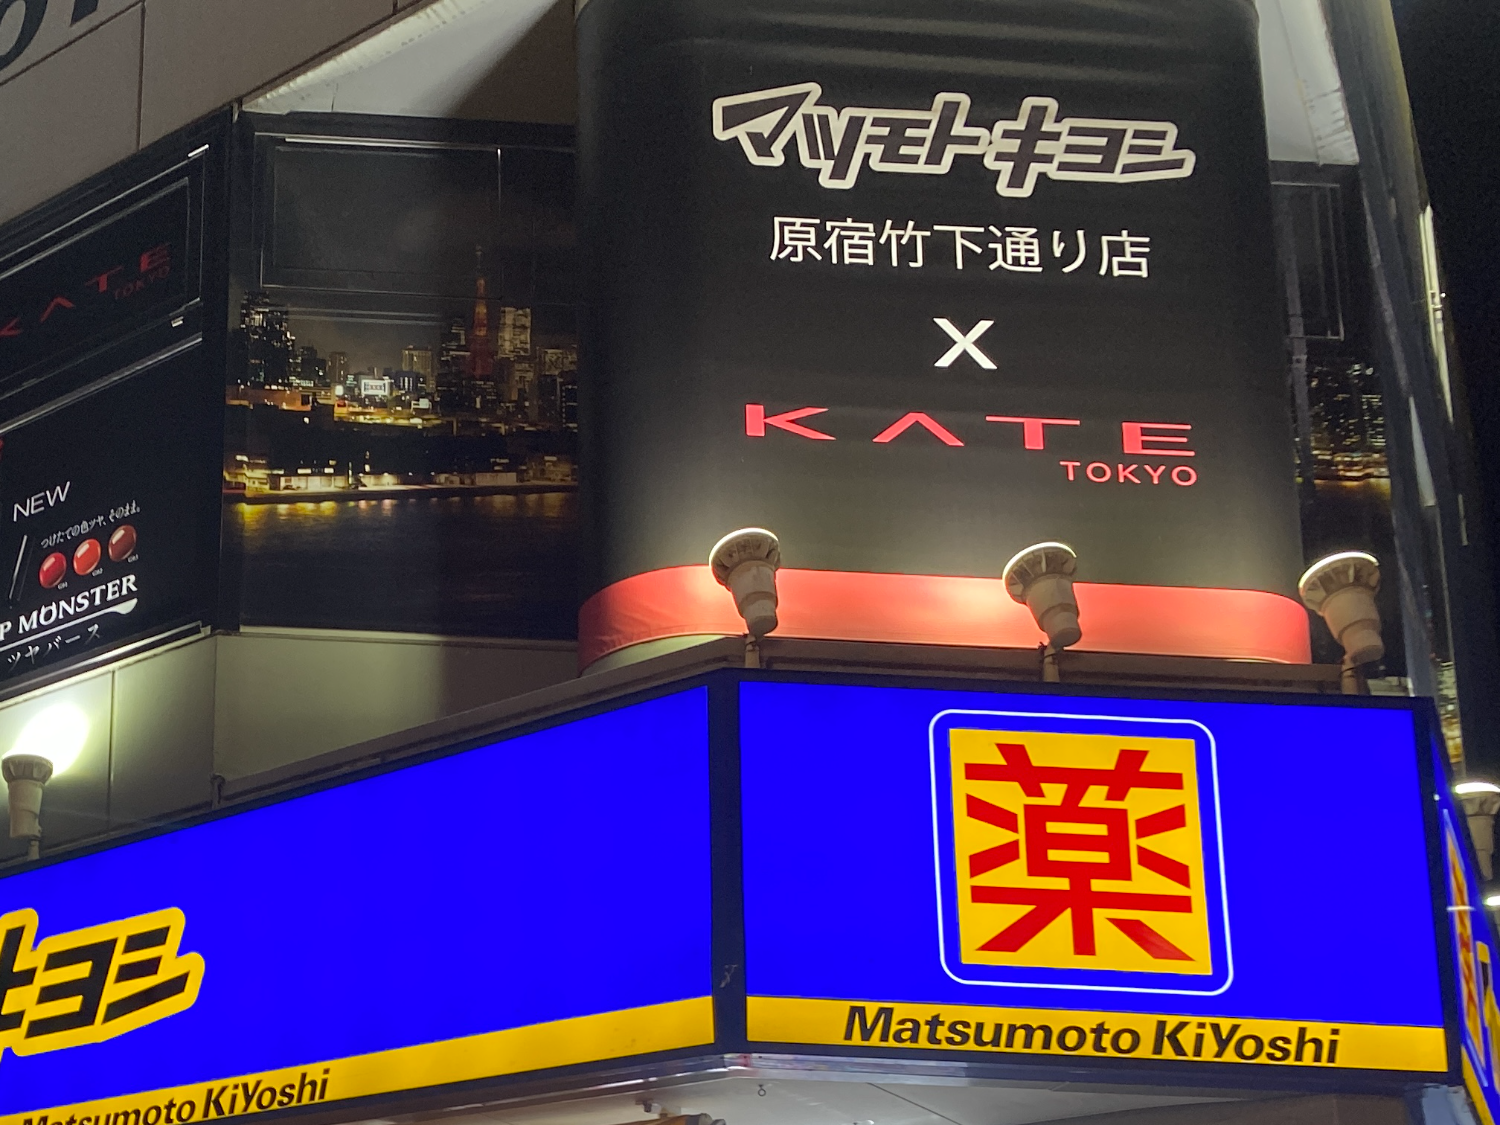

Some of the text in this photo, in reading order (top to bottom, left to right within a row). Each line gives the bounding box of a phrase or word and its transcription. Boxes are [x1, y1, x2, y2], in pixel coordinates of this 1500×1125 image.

[712, 82, 1196, 197] マツモトキヨシ
[769, 216, 1152, 279] 原宿竹下通り店
[12, 481, 71, 522] NEW
[1059, 460, 1198, 487] TOKYO
[17, 574, 139, 634] MONSTER
[7, 623, 101, 671] ツヤバース
[963, 743, 1198, 962] 薬
[843, 1004, 1341, 1065] Matsumoto KiYoshi
[201, 1068, 332, 1120] KiYoshi
